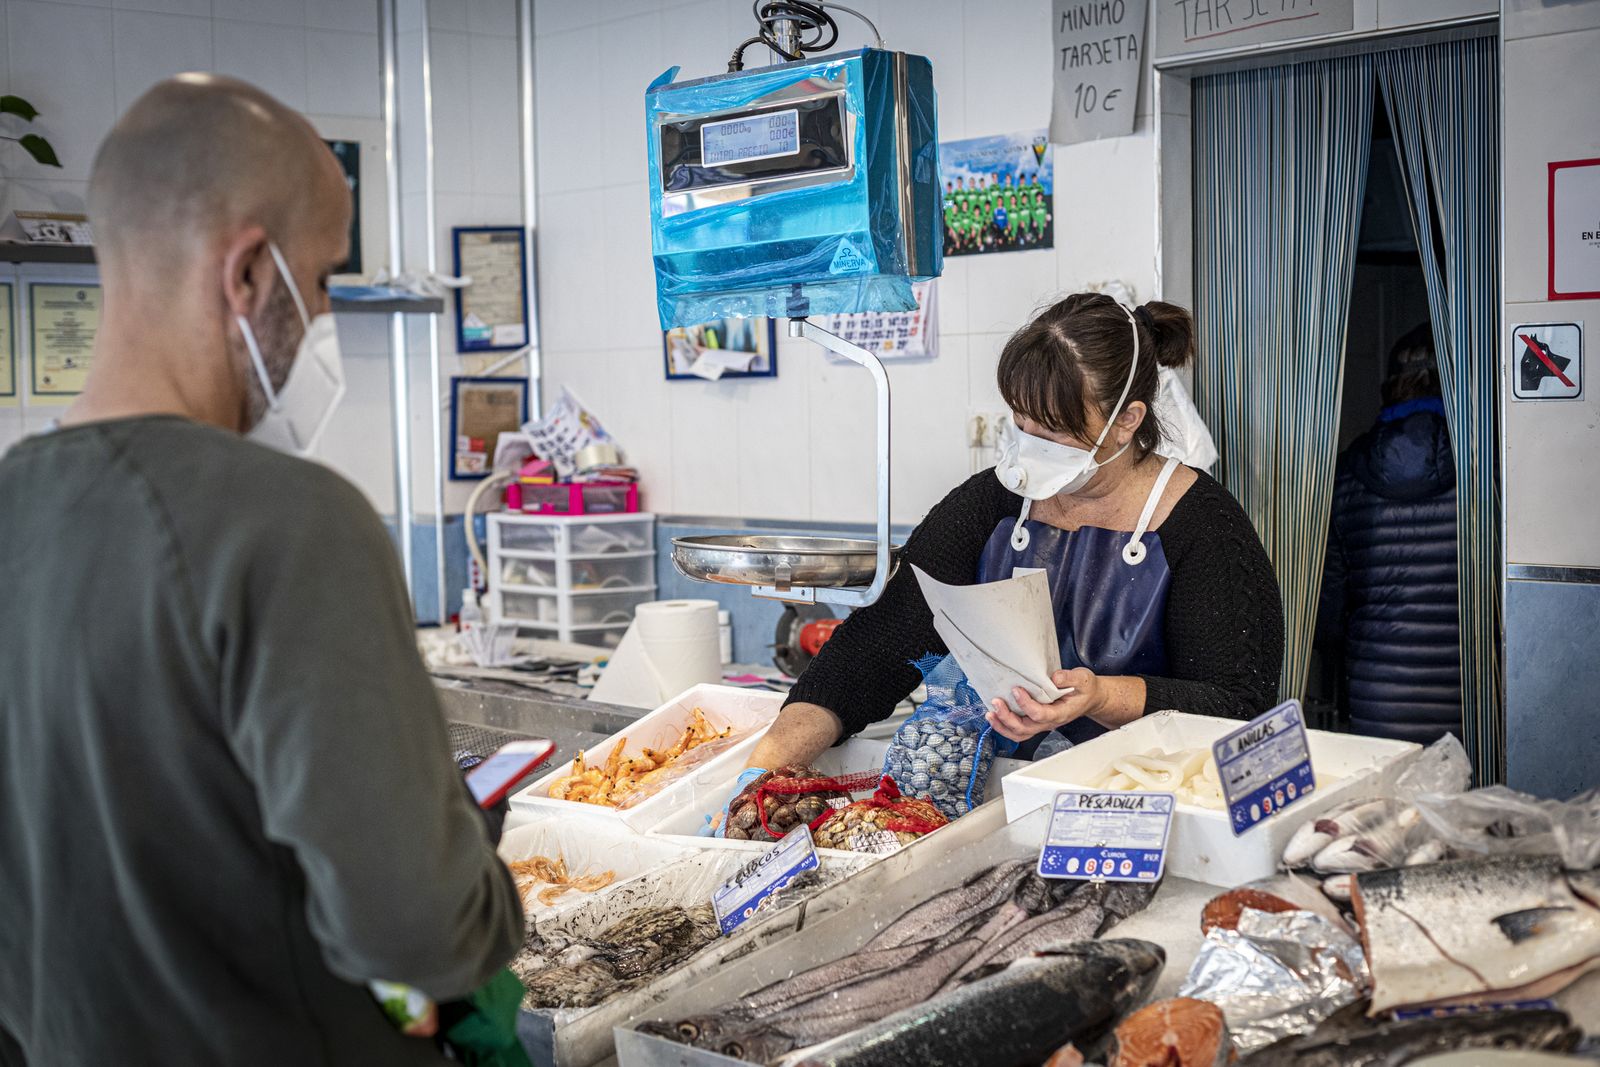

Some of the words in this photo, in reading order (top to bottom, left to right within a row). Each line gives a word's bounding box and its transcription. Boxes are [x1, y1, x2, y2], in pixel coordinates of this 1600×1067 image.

[1060, 0, 1125, 33] MINIMO
[1061, 33, 1138, 70] TARJETA
[1074, 83, 1098, 118] 10
[1102, 88, 1123, 112] €
[1581, 231, 1594, 241] EN
[833, 258, 867, 269] MINERVA
[1078, 793, 1146, 810] PESCADILLA
